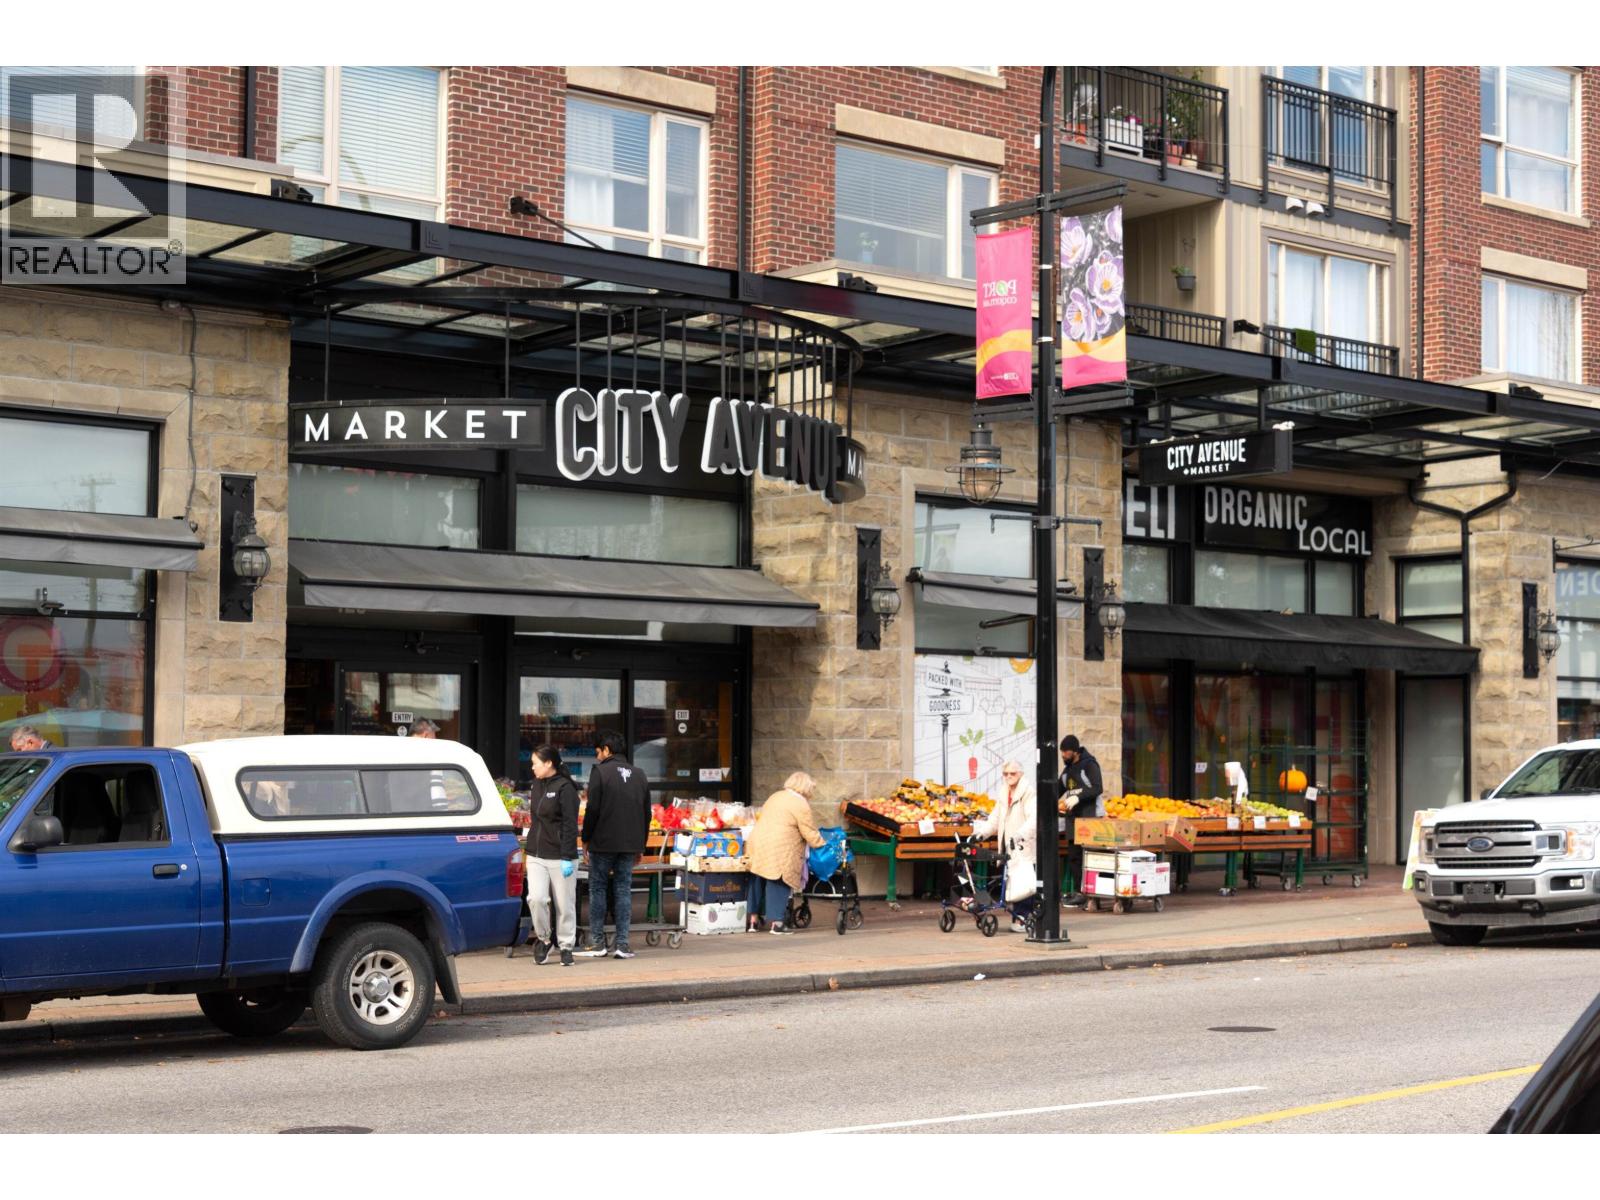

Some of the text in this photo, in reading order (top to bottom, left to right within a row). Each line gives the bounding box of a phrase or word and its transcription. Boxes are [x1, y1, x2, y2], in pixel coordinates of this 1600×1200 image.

[304, 409, 527, 443] MARKET
[555, 386, 691, 482] CITY
[1167, 438, 1247, 471] CITY AVENUE
[1190, 463, 1230, 476] MARKET
[1121, 478, 1176, 540] ELI
[1204, 486, 1309, 530] ORGANIC
[1298, 526, 1372, 556] LOCAL
[928, 672, 949, 687] PACKED
[677, 711, 688, 720] EXIT
[929, 699, 961, 712] GOODNESS
[394, 713, 412, 722] ENTRY
[455, 833, 500, 843] EDGE
